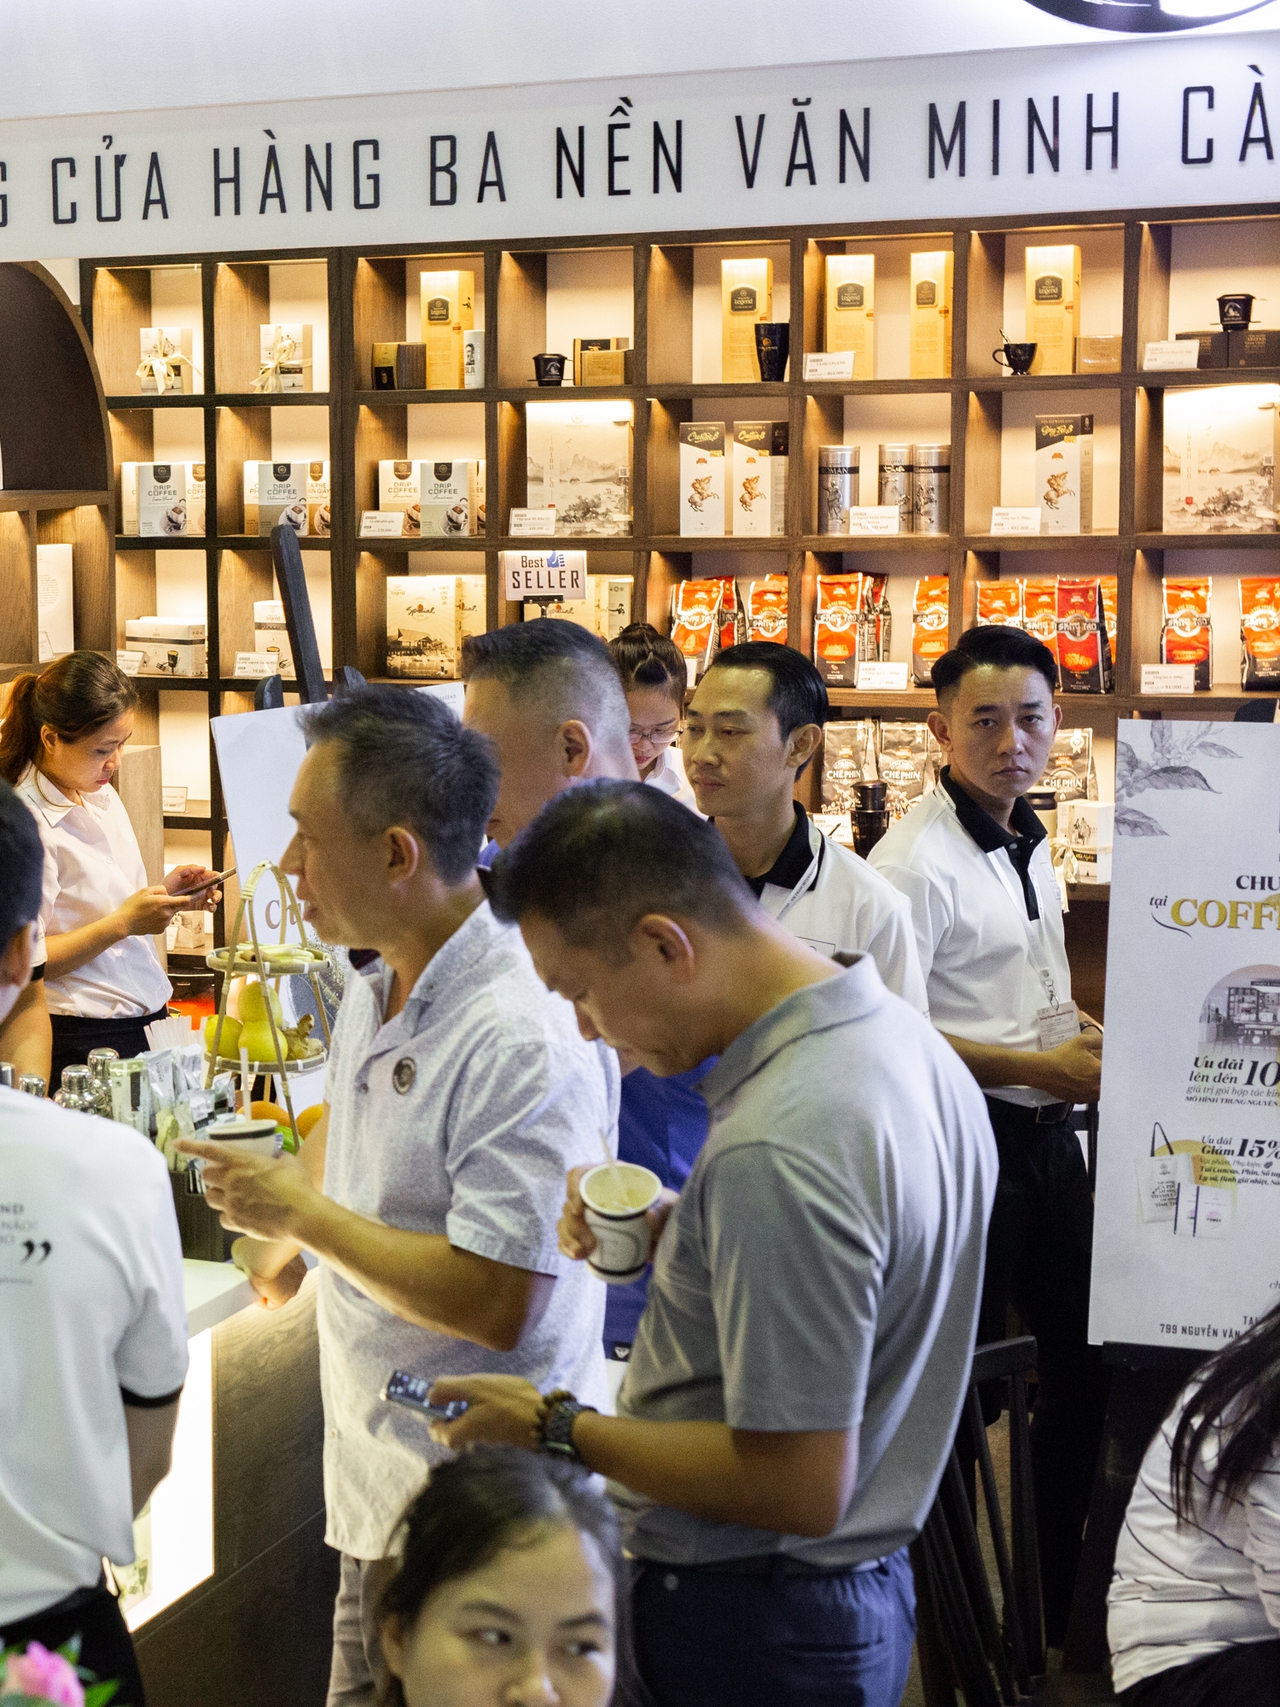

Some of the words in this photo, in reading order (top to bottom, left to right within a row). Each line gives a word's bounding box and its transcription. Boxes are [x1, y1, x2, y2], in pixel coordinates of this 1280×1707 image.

[51, 135, 169, 224] CỬA
[213, 129, 380, 216] HÀNG
[430, 131, 506, 206] BA
[556, 97, 682, 199] NỀN
[735, 97, 870, 189] VĂN
[928, 92, 1119, 179] MINH
[1181, 65, 1274, 165] CÀ
[521, 556, 544, 568] Best
[512, 570, 579, 589] SELLER
[1150, 895, 1168, 909] tại
[1171, 898, 1280, 931] COFF
[1217, 1058, 1244, 1070] đãi
[1189, 1071, 1209, 1083] lên
[1213, 1072, 1238, 1084] đến
[1236, 1138, 1280, 1159] 15%
[1160, 1324, 1177, 1334] 799
